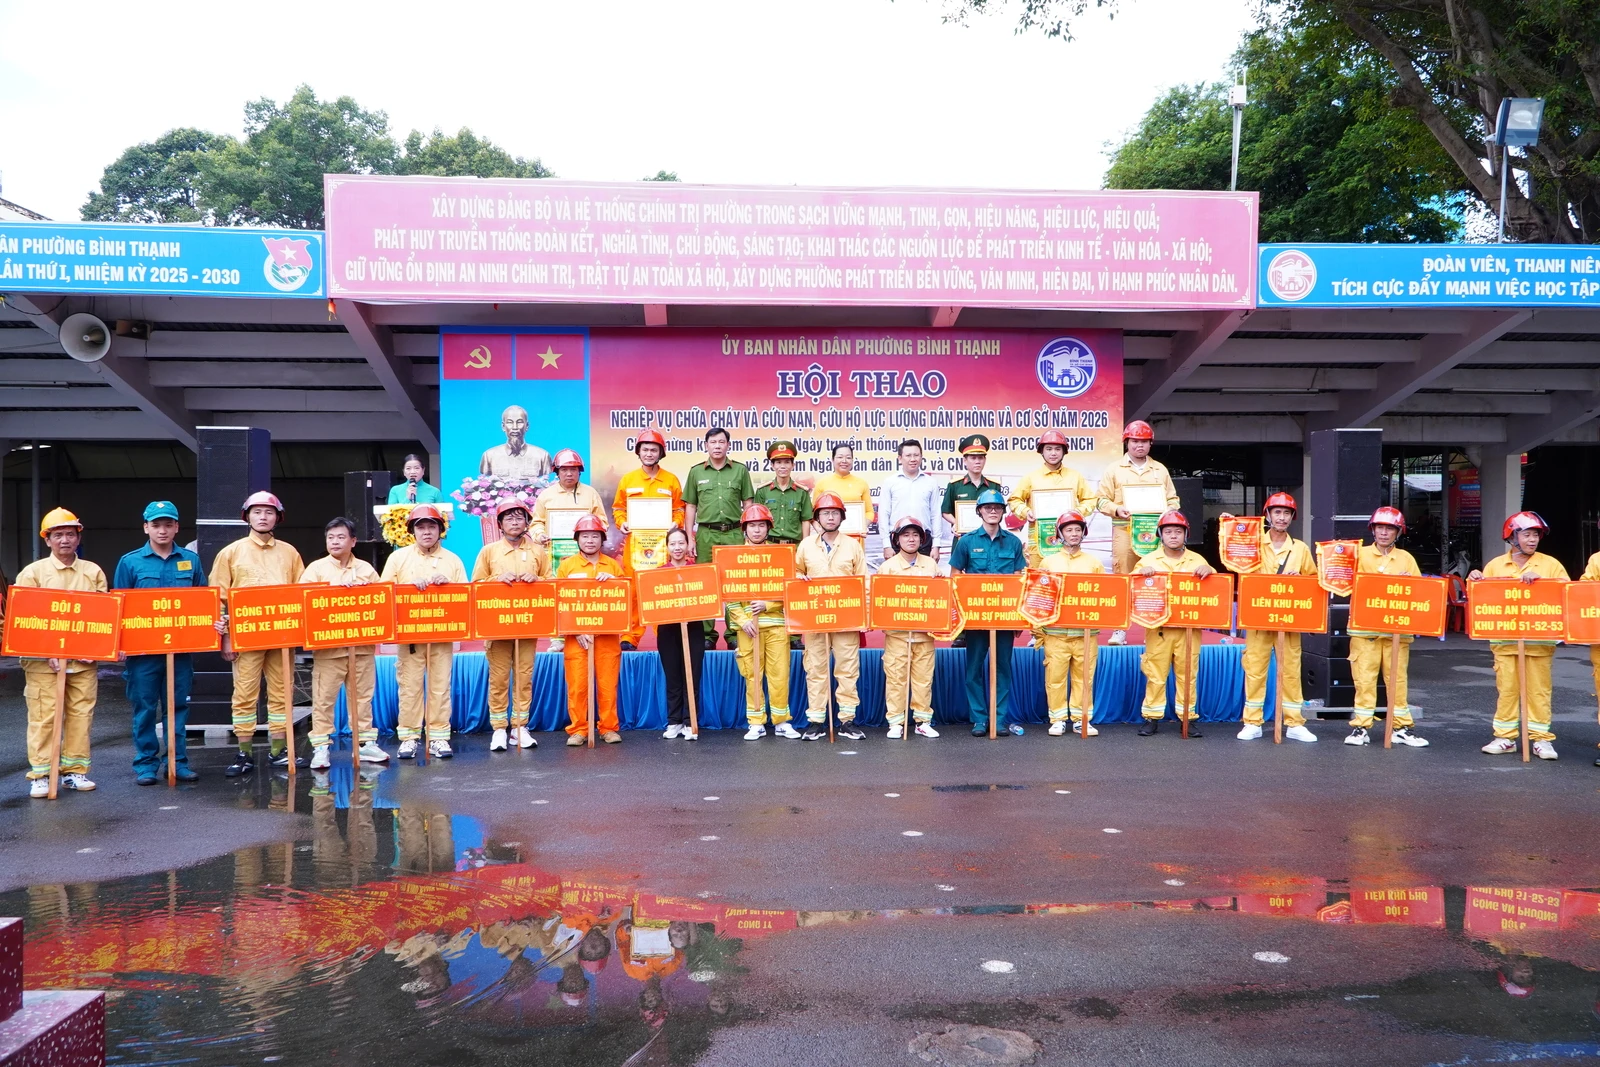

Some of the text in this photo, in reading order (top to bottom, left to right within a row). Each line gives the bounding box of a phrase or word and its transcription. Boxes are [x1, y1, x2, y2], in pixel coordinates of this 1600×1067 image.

[432, 192, 1160, 233] XÂY DỰNG ĐẢNG BỘ VÀ HỆ THỐNG CHÍNH TRỊ PHƯỜNG TRONG SẠCH VỮNG MẠNH, TINH, GỌN, HIỆU NĂNG, HIỆU LỰC, HIỆU QUẢ;
[0, 257, 23, 279] ẦN
[26, 260, 58, 280] THỨ
[74, 262, 124, 284] NHIỆM
[128, 262, 147, 282] KỲ
[150, 266, 188, 284] 2025
[202, 268, 240, 285] 2030
[1331, 273, 1600, 299] TÍCH CỰC ĐẨY MẠNH VIỆC HỌC TẬP
[721, 333, 1001, 359] ỦY BAN NHÂN DÂN PHƯỜNG BÌNH THẠNH
[778, 364, 947, 404] HỘI THAO
[611, 404, 1108, 432] NGHIỆP VỤ CHỮA CHÁY VÀ CỨU NẠN, CỨU HỘ LỰC LƯỢNG DÂN PHÒNG VÀ CƠ SỞ NĂM 2026
[746, 435, 1009, 454] 65 Ngày thống lượng sát
[746, 457, 946, 471] và dân và
[737, 552, 771, 564] CÔNG TY
[725, 569, 747, 578] TNHH
[749, 569, 760, 578] MI
[654, 581, 703, 595] CÔNG TY TNHH
[808, 585, 841, 596] ĐẠI HỌC
[895, 583, 928, 594] CÔNG TY
[981, 581, 1004, 592] ĐOÀN
[1077, 581, 1100, 594] ĐỘI 2
[1270, 582, 1294, 595] ĐỘI 4
[1386, 583, 1411, 596] ĐỘI 5
[312, 591, 386, 610] ĐỘI PCCC CƠ SỞ
[477, 594, 555, 609] TRƯỜNG CAO ĐẲNG
[967, 595, 1017, 607] BAN CHỈ HUY
[1080, 597, 1097, 606] KHU
[1099, 595, 1117, 607] PHỐ
[1505, 588, 1531, 601] ĐỘI 6
[51, 600, 81, 615] ĐỘI 8
[642, 594, 717, 611] MH PROPERTIES CORP
[790, 597, 861, 611] KINH TẾ TÀI CHÍNH
[1251, 596, 1313, 610] LIÊN KHU PHỐ
[1366, 596, 1430, 612] LIÊN KHU PHỐ
[1475, 603, 1562, 615] CÔNG AN PHƯỜNG
[235, 603, 302, 618] CÔNG TY TNHH
[328, 610, 377, 624] CHUNG CƯ
[893, 612, 928, 622] (VISSAN)
[1075, 611, 1100, 621] 11-20
[14, 615, 113, 635] PHƯỜNG BÌNH LỢI TRUNG
[498, 612, 534, 626] ĐẠI VIỆT
[576, 616, 603, 626] VITACO
[815, 613, 837, 625] (UEF)
[1268, 613, 1294, 624] 31-40
[1383, 615, 1410, 626] 41-50
[1474, 618, 1564, 631] KHU PHỐ 51-52-53
[236, 619, 257, 634] BẾN
[258, 620, 271, 632] XE
[313, 626, 385, 641] THANH ĐA VIEW
[59, 638, 65, 649] 1
